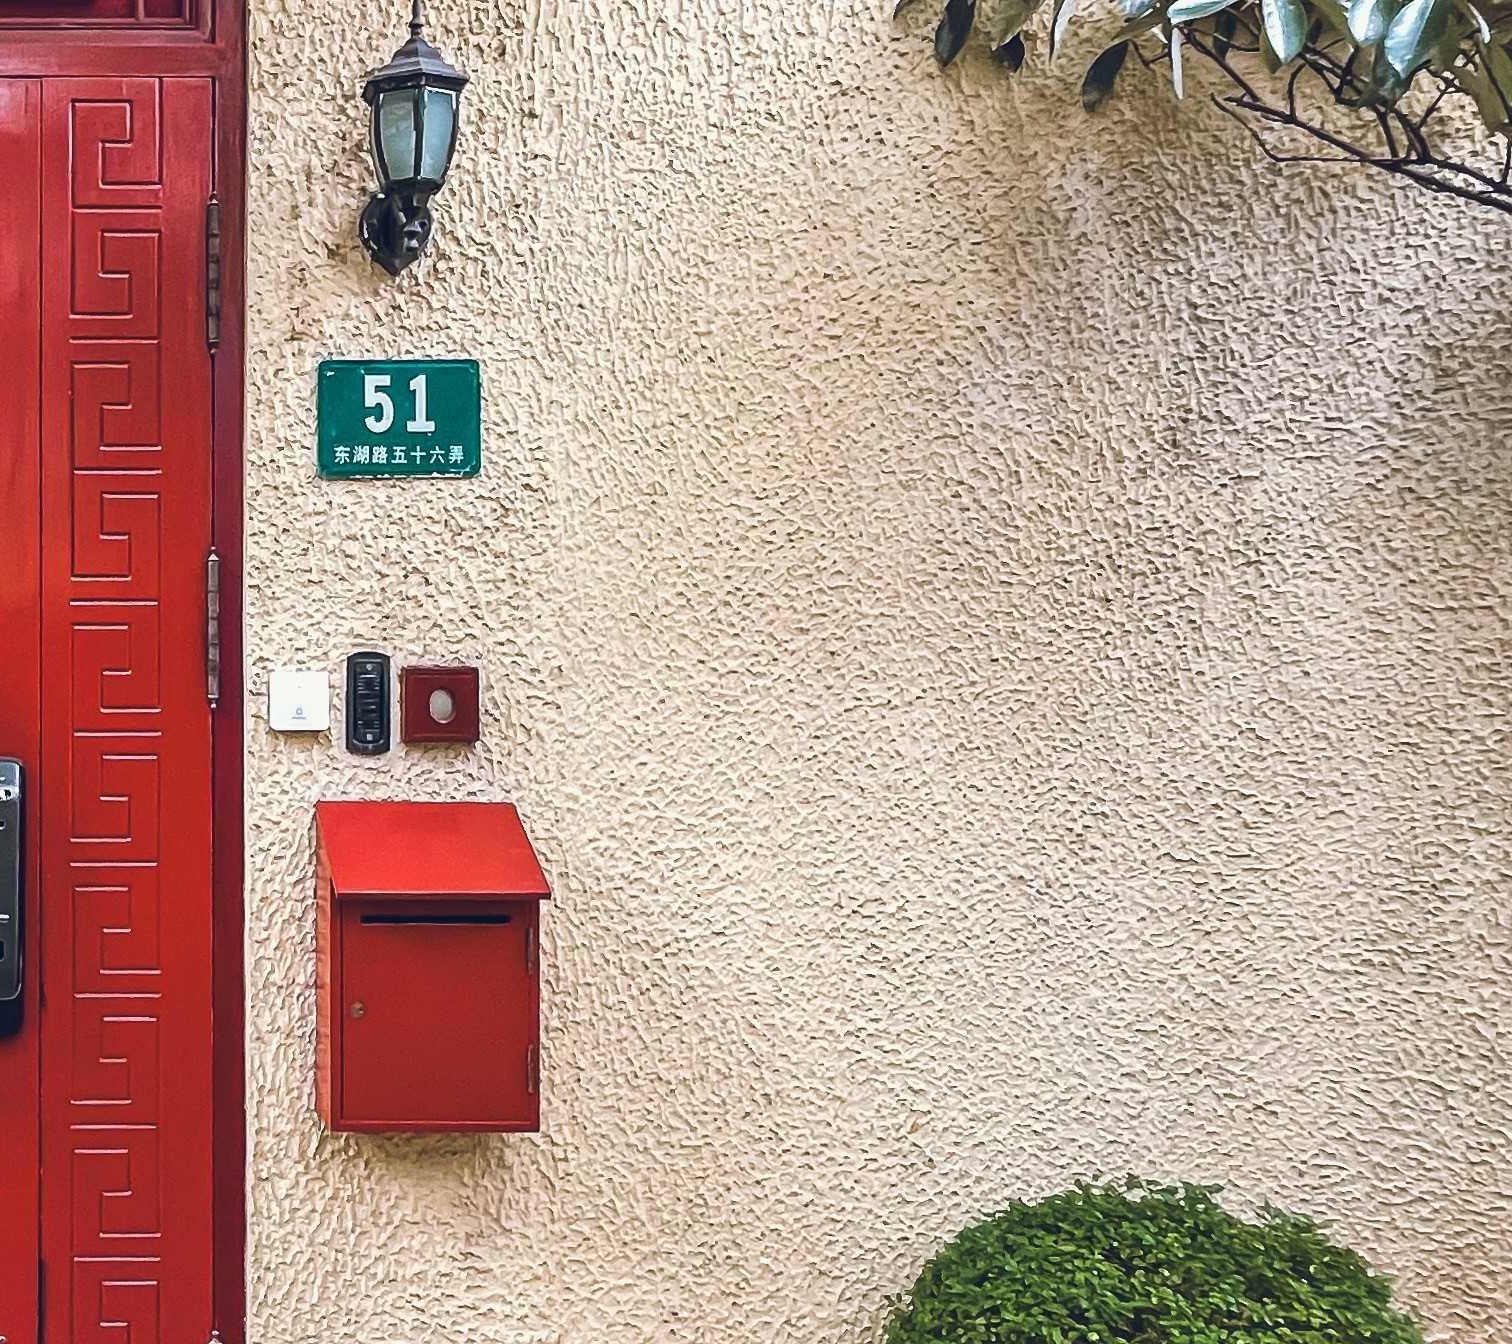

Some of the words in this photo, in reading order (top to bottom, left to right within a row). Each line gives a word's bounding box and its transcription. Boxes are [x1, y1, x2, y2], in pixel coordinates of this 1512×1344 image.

[364, 374, 436, 433] 51
[334, 445, 464, 465] 东湖路五十六弄
